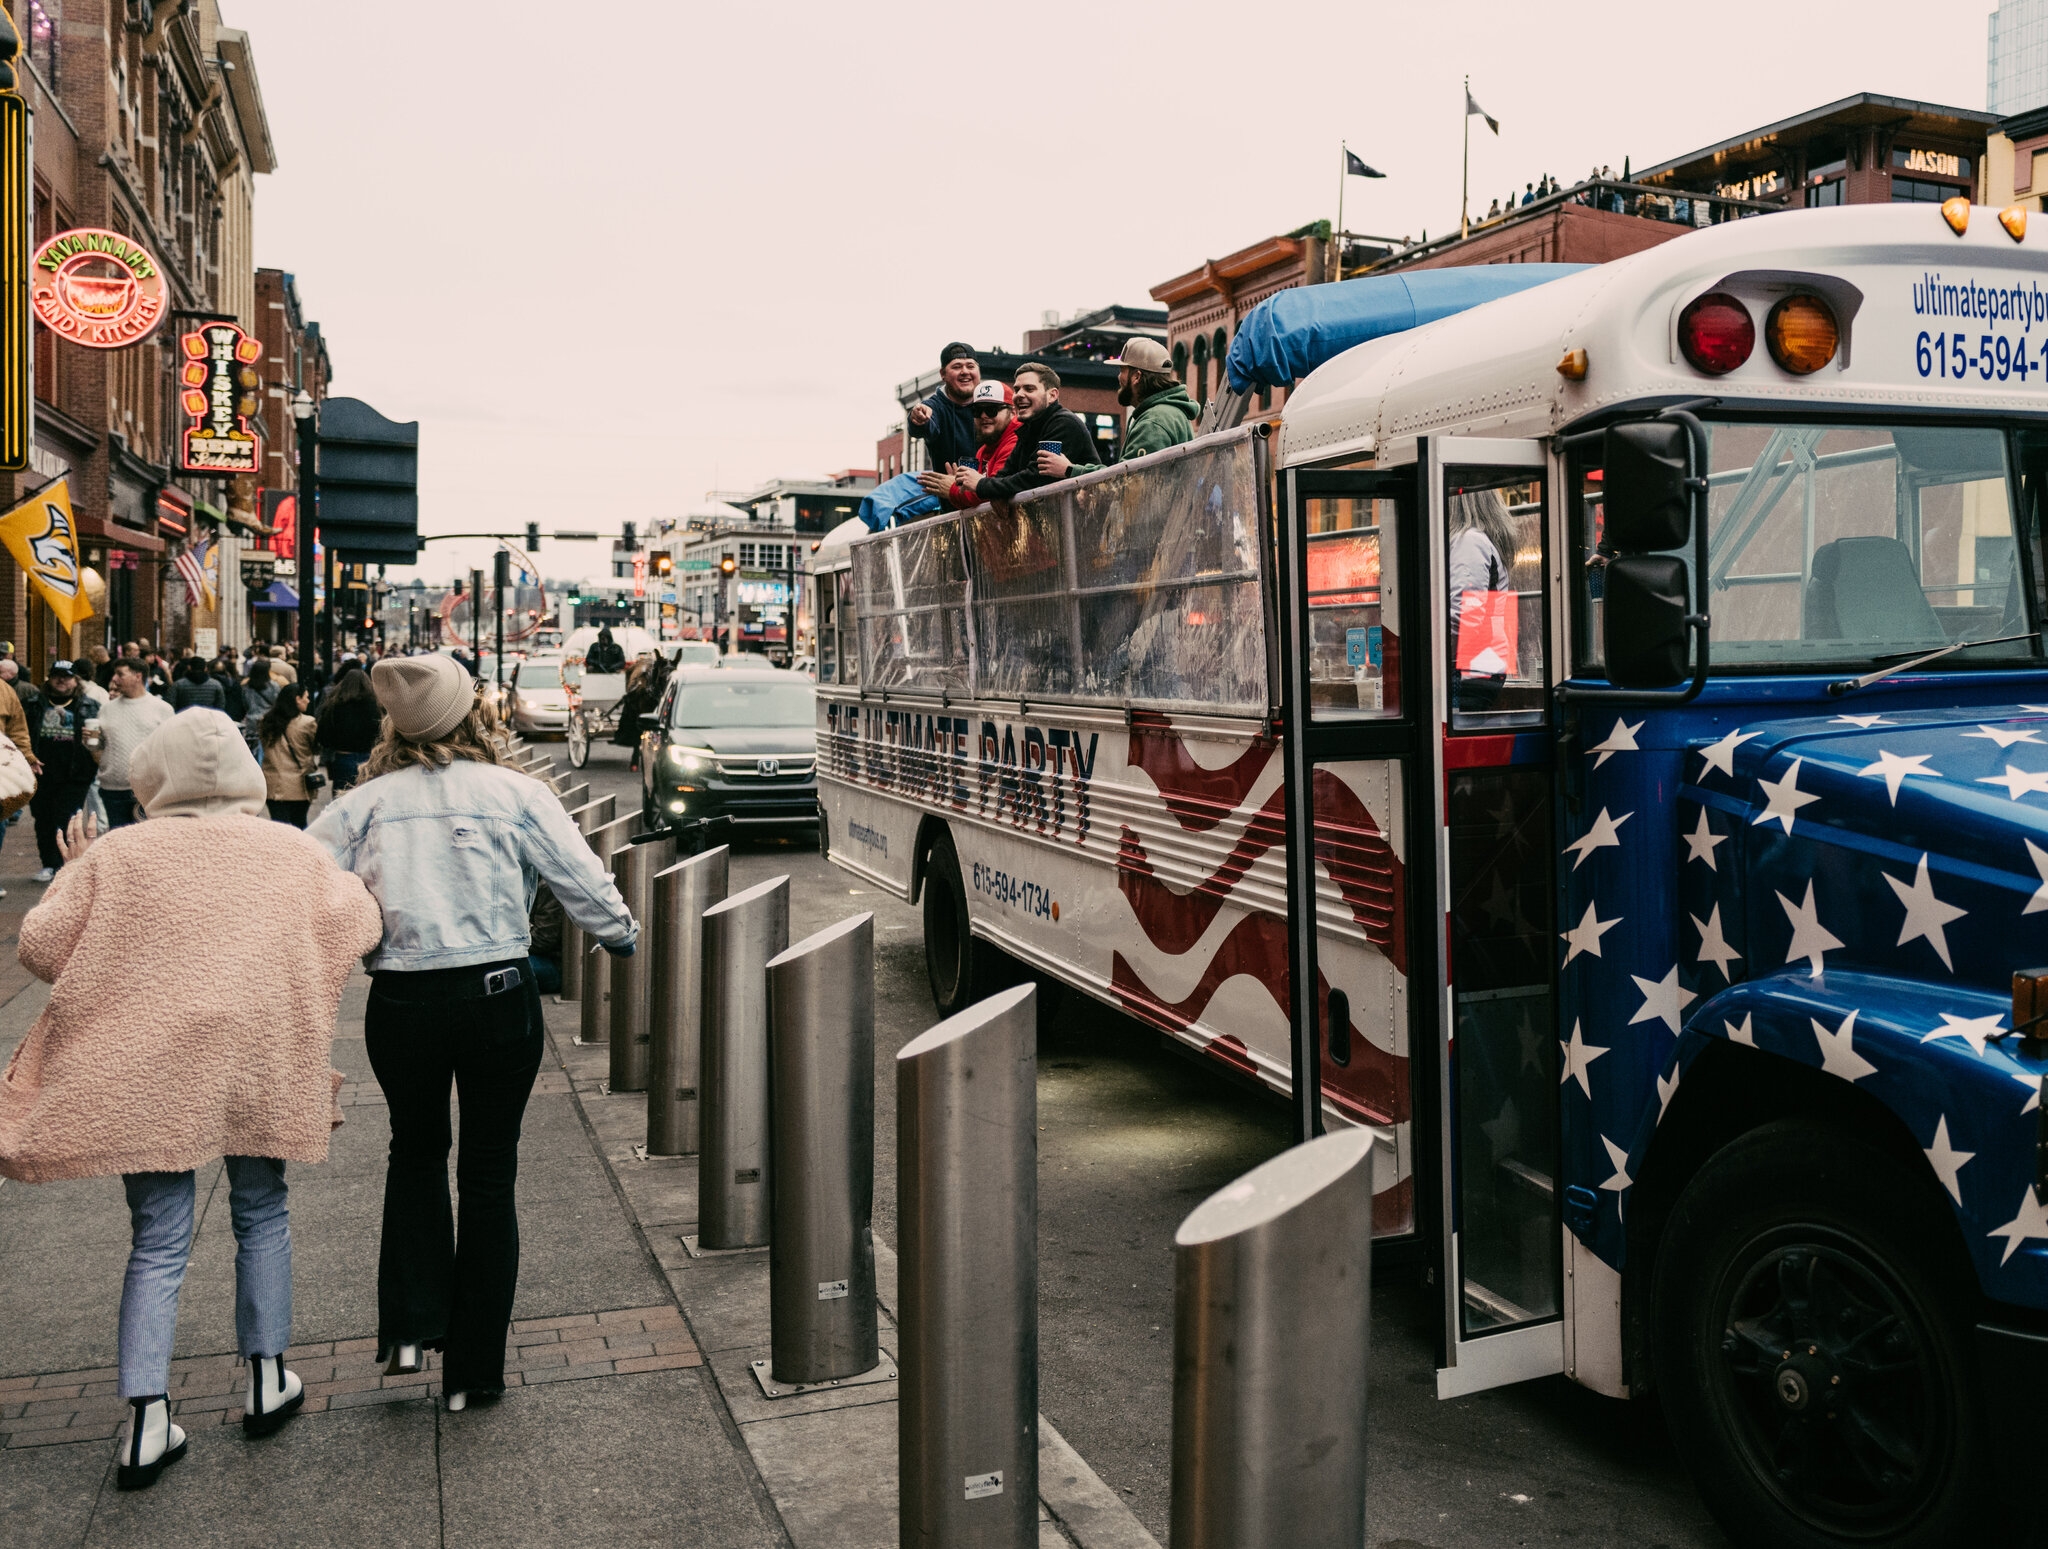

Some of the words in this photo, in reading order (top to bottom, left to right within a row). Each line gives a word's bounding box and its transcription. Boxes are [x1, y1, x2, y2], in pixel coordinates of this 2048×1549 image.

[1904, 149, 1959, 177] JASON
[38, 233, 156, 279] SAVANNAH'S
[36, 287, 89, 338] CANDY
[92, 295, 158, 342] KITCHEN
[211, 328, 237, 438] WHISKEY
[189, 438, 254, 455] BENT
[189, 451, 254, 469] Saloon
[827, 703, 861, 784] THE
[864, 707, 970, 814] ULTIMATE
[977, 721, 1099, 848] PARTY
[973, 862, 1050, 921] 615-594-1734
